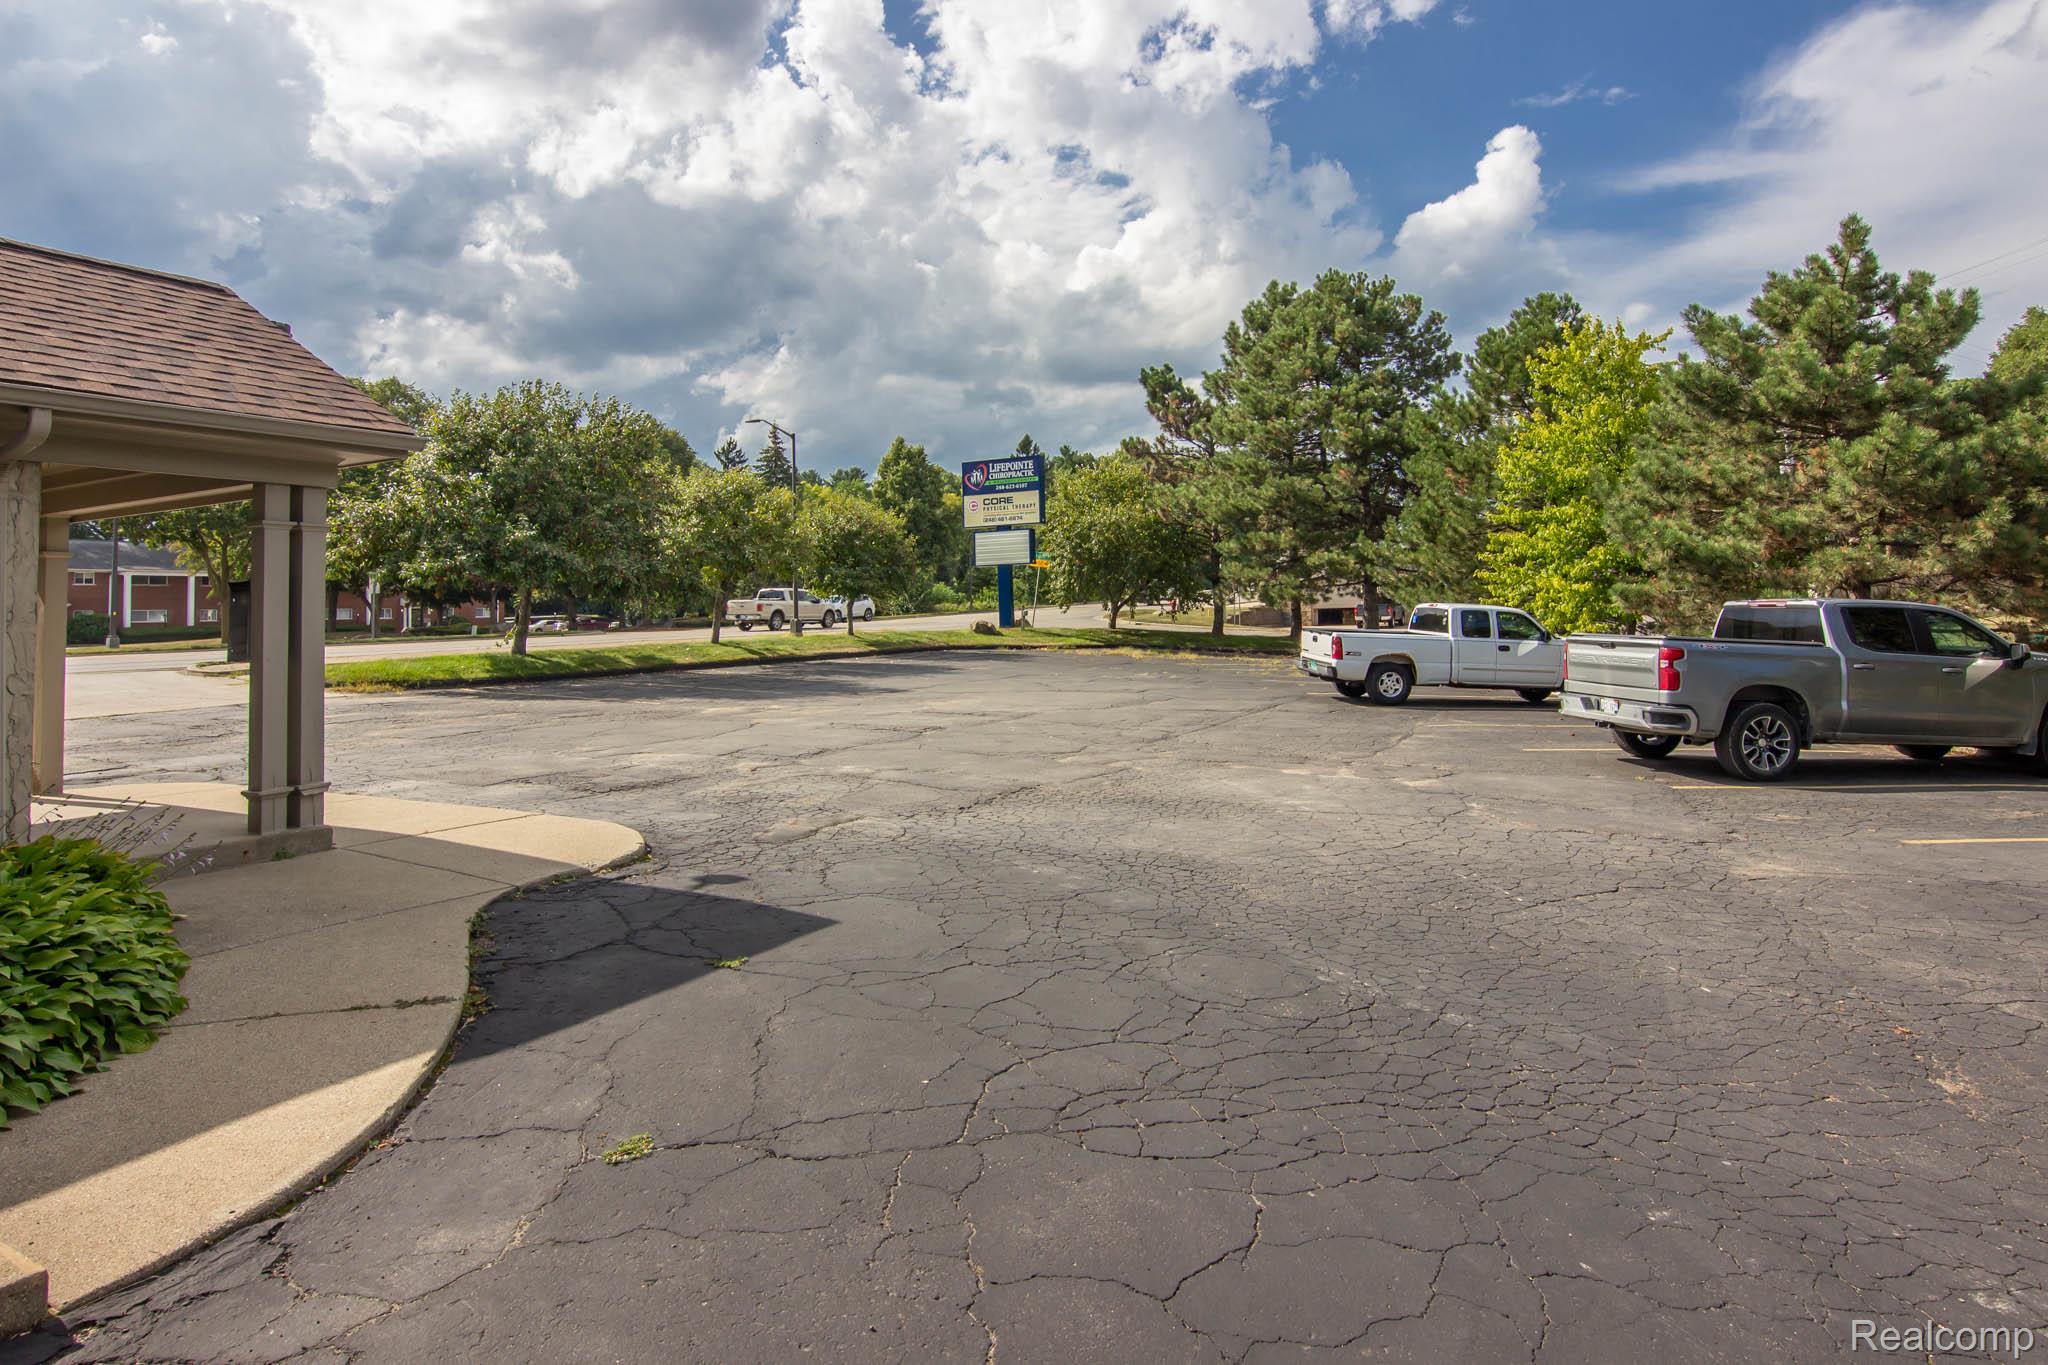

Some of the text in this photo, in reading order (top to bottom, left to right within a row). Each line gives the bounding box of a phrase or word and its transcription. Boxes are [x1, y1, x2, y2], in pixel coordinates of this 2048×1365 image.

[989, 460, 1034, 472] LIFEPOINTE
[989, 470, 1034, 480] CHIROPRACTIC
[983, 496, 1014, 506] CORE
